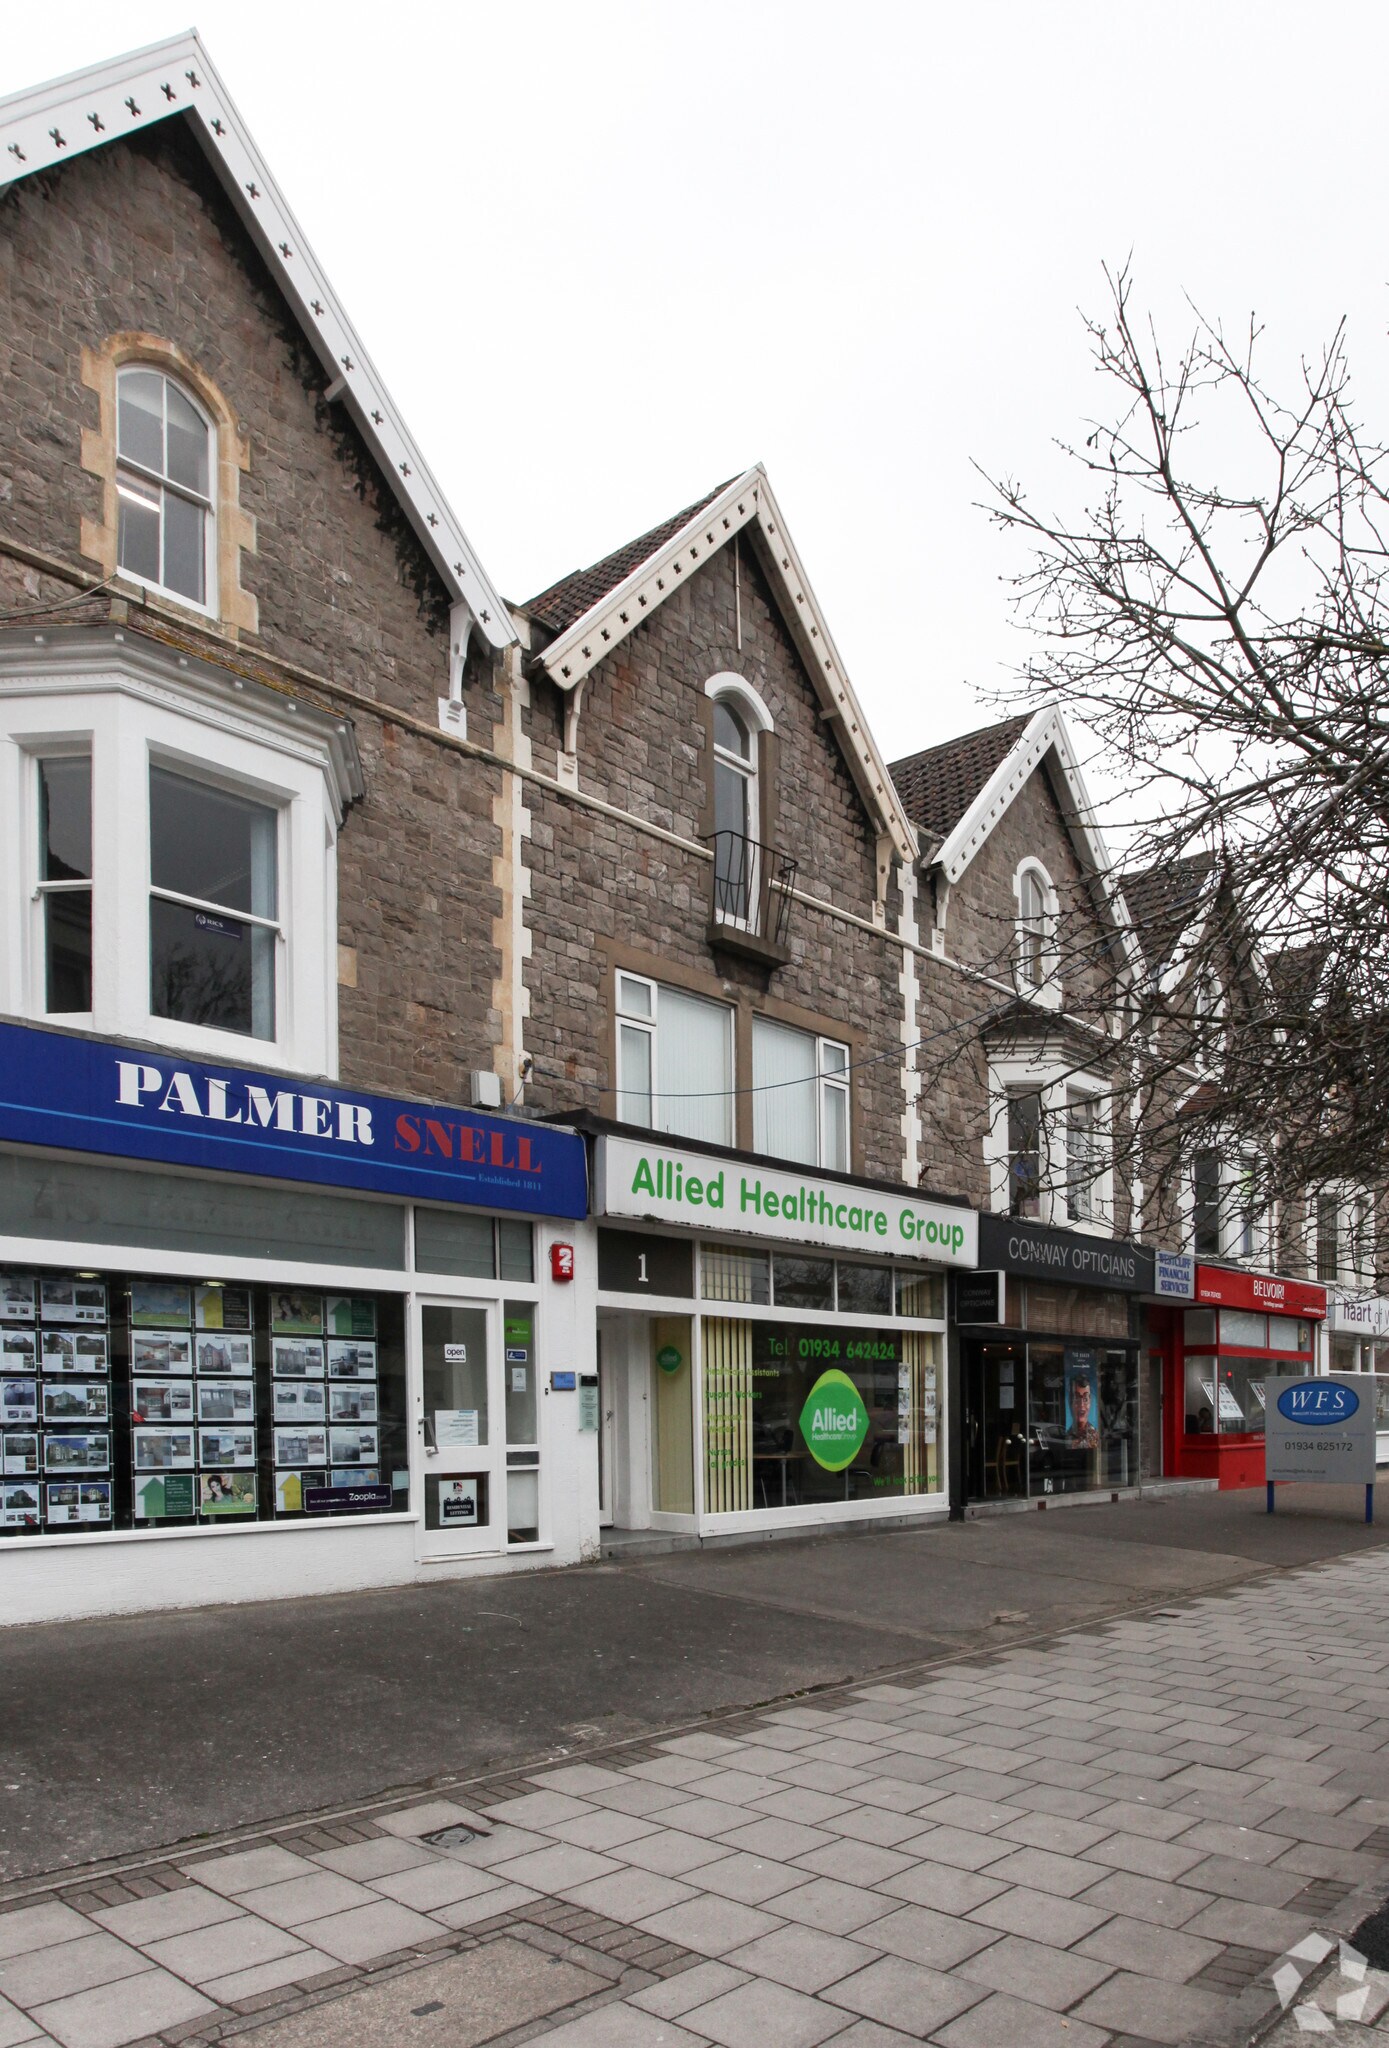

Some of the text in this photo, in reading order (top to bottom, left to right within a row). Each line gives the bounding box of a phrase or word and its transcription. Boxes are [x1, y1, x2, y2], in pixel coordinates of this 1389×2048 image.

[115, 1060, 542, 1173] PALMER SNELL
[478, 1172, 520, 1188] Established
[631, 1157, 964, 1254] Allied Healthcare Group
[637, 1253, 649, 1283] 1
[1008, 1237, 1135, 1278] CONWAY OPTICIANS
[1158, 1266, 1191, 1282] FINANCIAL
[1160, 1280, 1189, 1294] SERVICES
[1343, 1300, 1372, 1323] haart
[446, 1348, 465, 1357] open
[798, 1338, 840, 1358] 01934
[846, 1340, 896, 1360] 642424
[811, 1407, 857, 1432] Allied
[1284, 1441, 1353, 1452] 01934 625172
